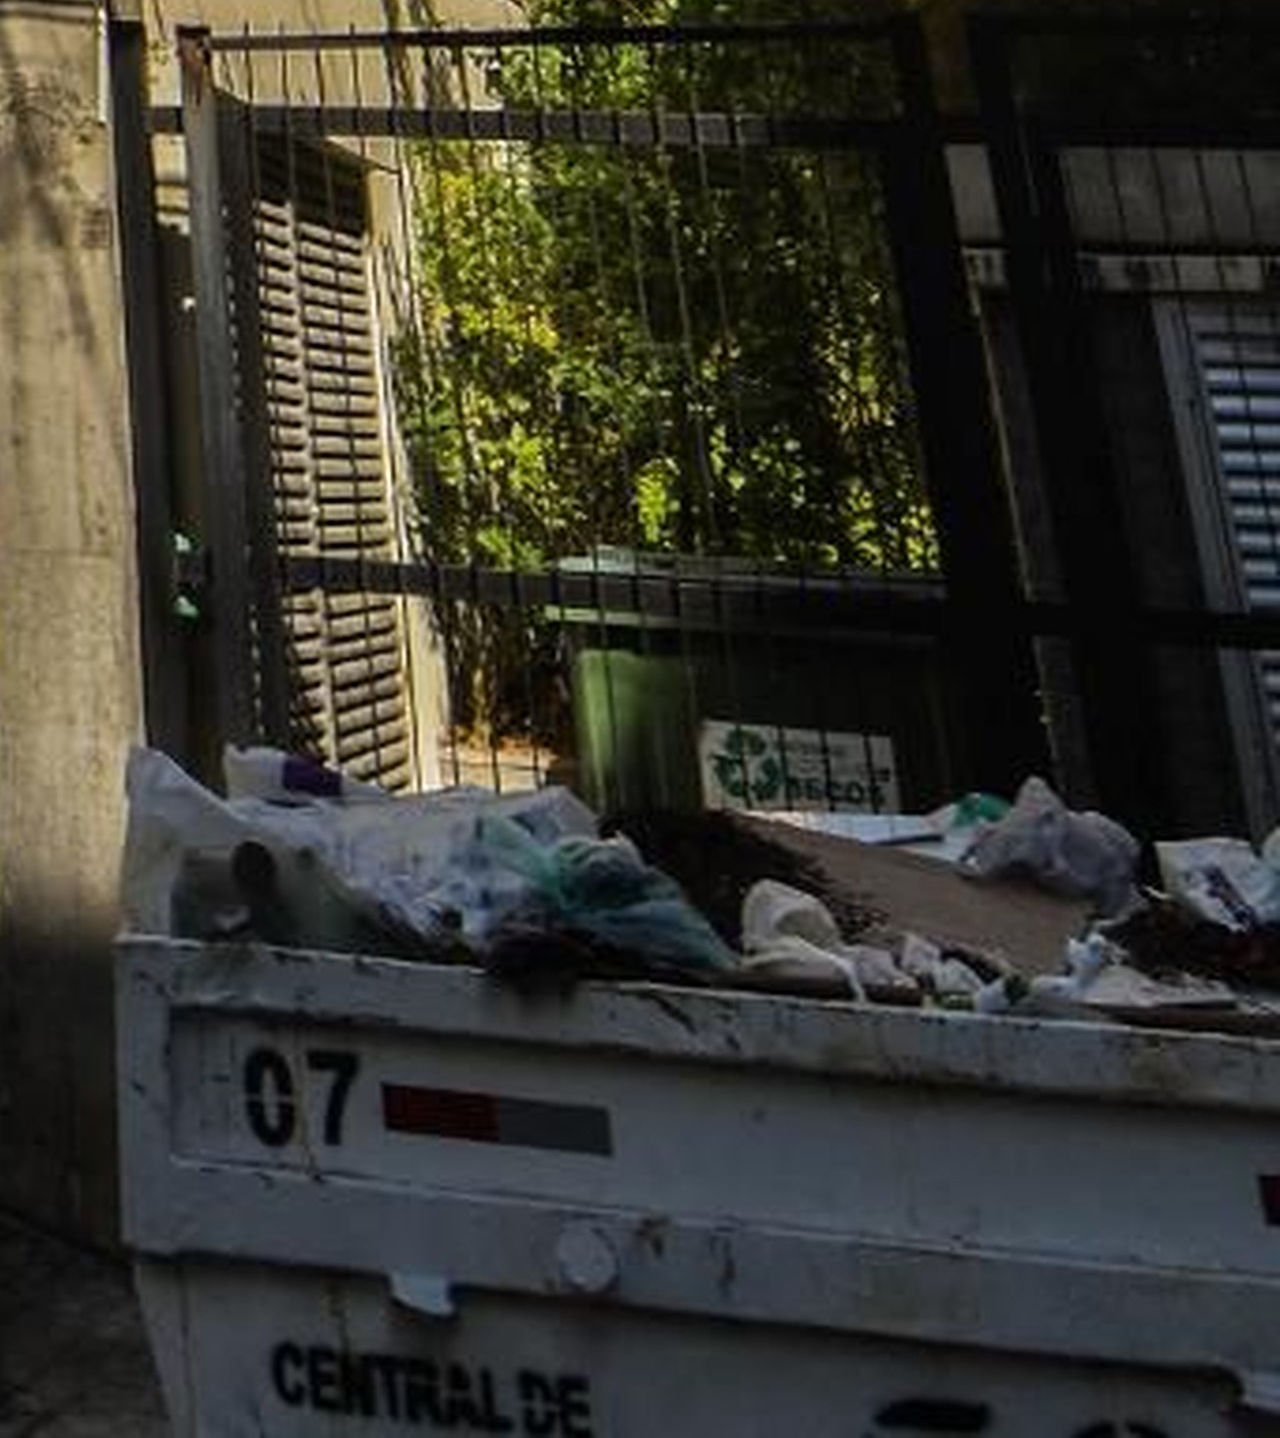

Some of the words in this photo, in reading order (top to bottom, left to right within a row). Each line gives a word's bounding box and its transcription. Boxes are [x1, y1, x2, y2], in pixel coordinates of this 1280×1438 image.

[244, 1047, 360, 1147] 07
[270, 1341, 515, 1433] CENTRAL
[515, 1365, 595, 1438] DE
